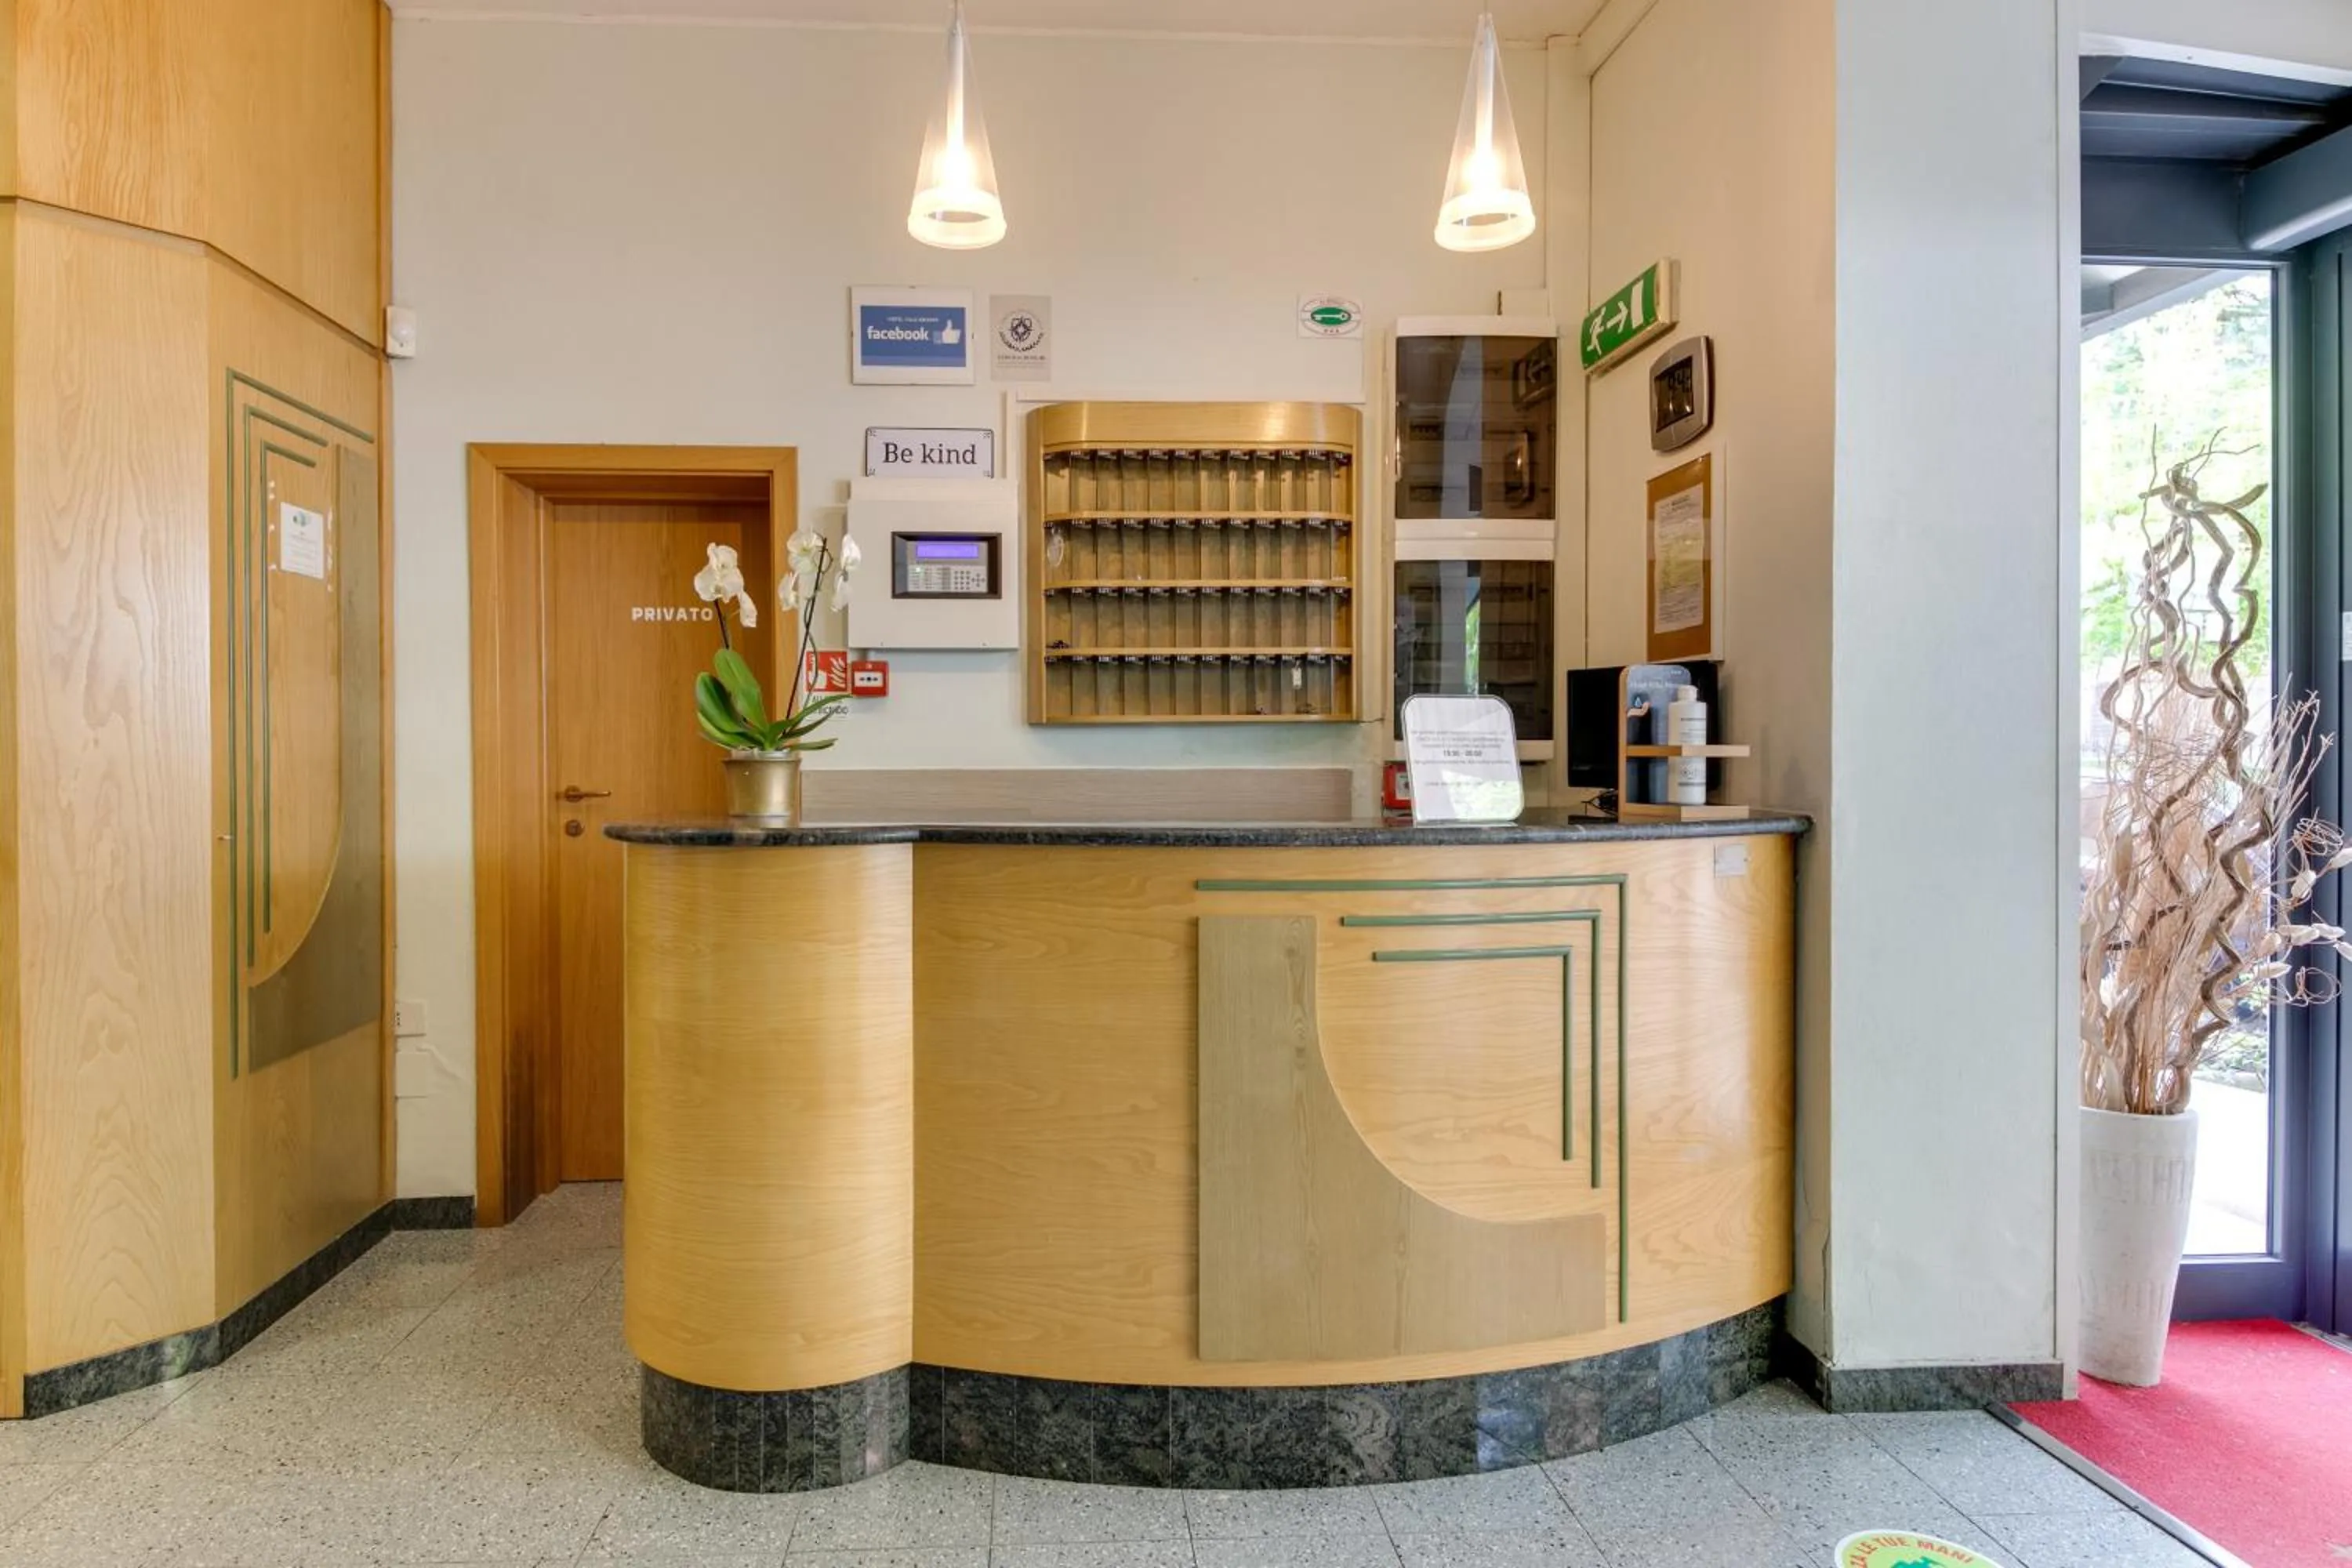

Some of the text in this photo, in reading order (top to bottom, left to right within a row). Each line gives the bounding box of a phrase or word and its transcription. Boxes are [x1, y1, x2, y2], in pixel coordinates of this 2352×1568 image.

[867, 325, 929, 341] facebook
[882, 441, 978, 465] Be kind
[630, 607, 713, 622] PRIVATO
[1872, 1535, 1911, 1548] TUE
[1917, 1539, 1974, 1564] MANI
